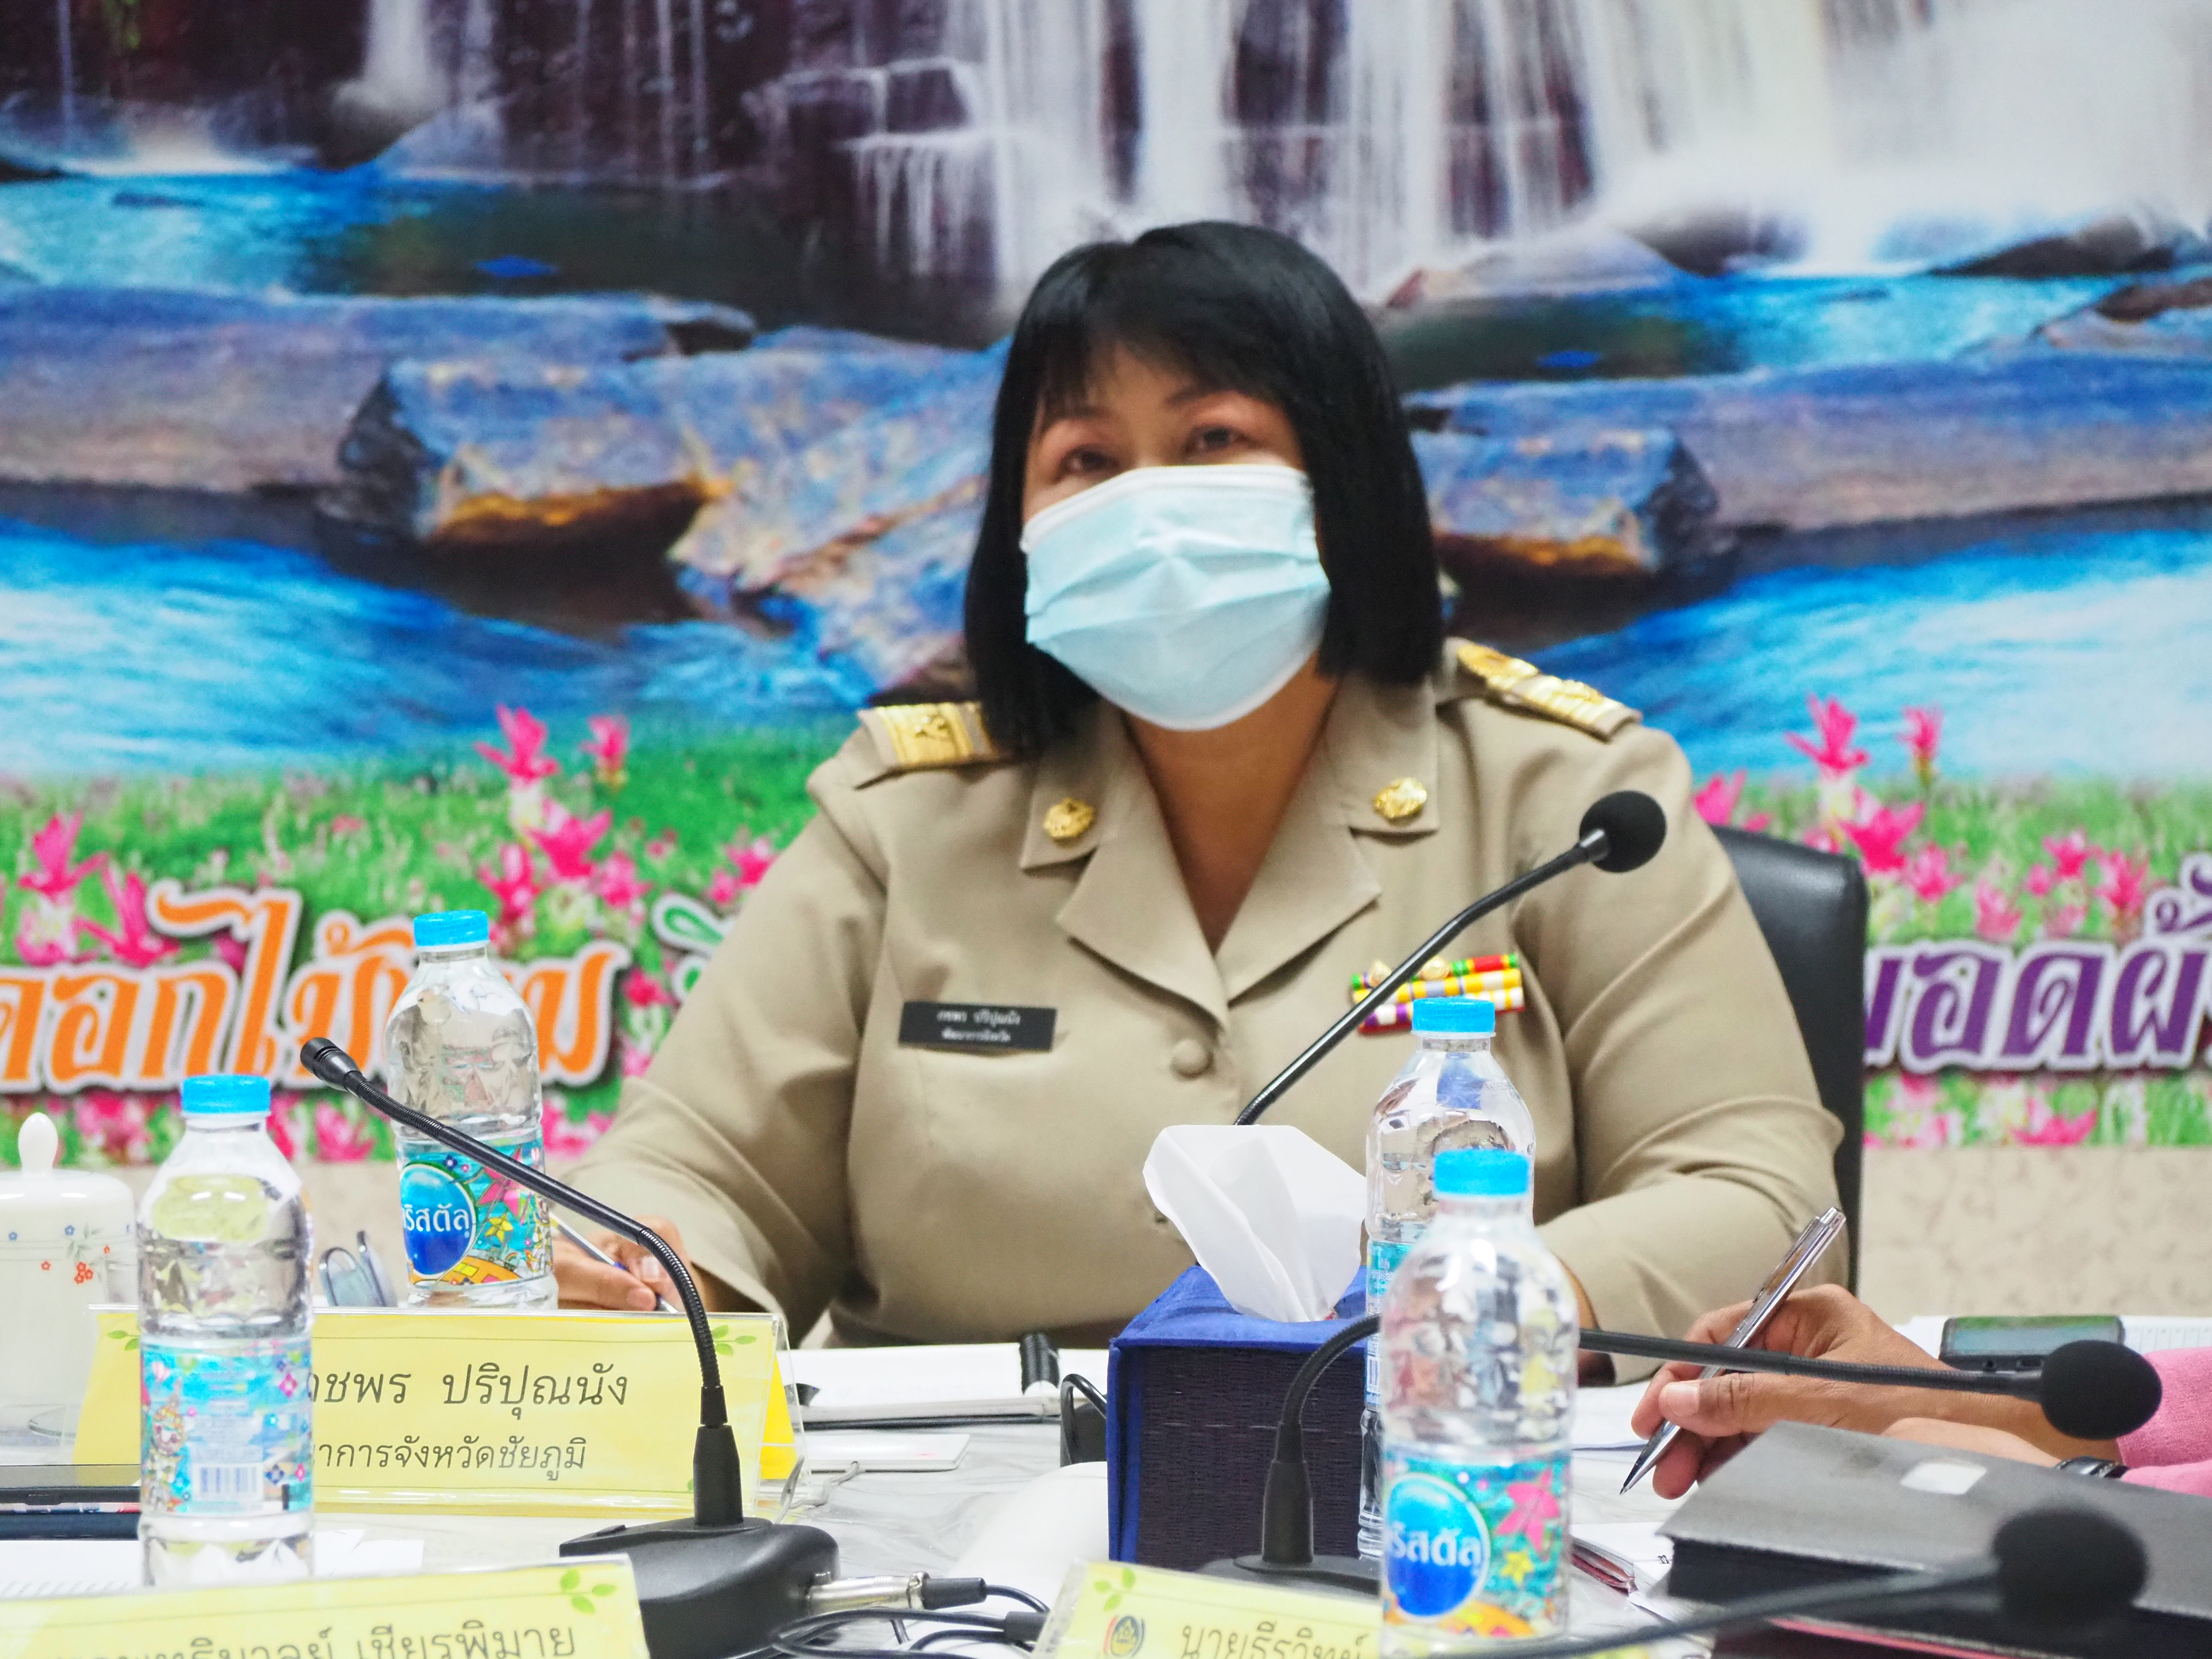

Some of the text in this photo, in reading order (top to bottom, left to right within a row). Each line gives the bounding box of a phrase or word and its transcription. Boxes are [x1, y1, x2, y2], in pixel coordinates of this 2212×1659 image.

[443, 1362, 627, 1420] ปริปุณนัง
[313, 1435, 587, 1481] าการจังหวัดชัยภูมิ
[1386, 1521, 1481, 1566] ริสตัล
